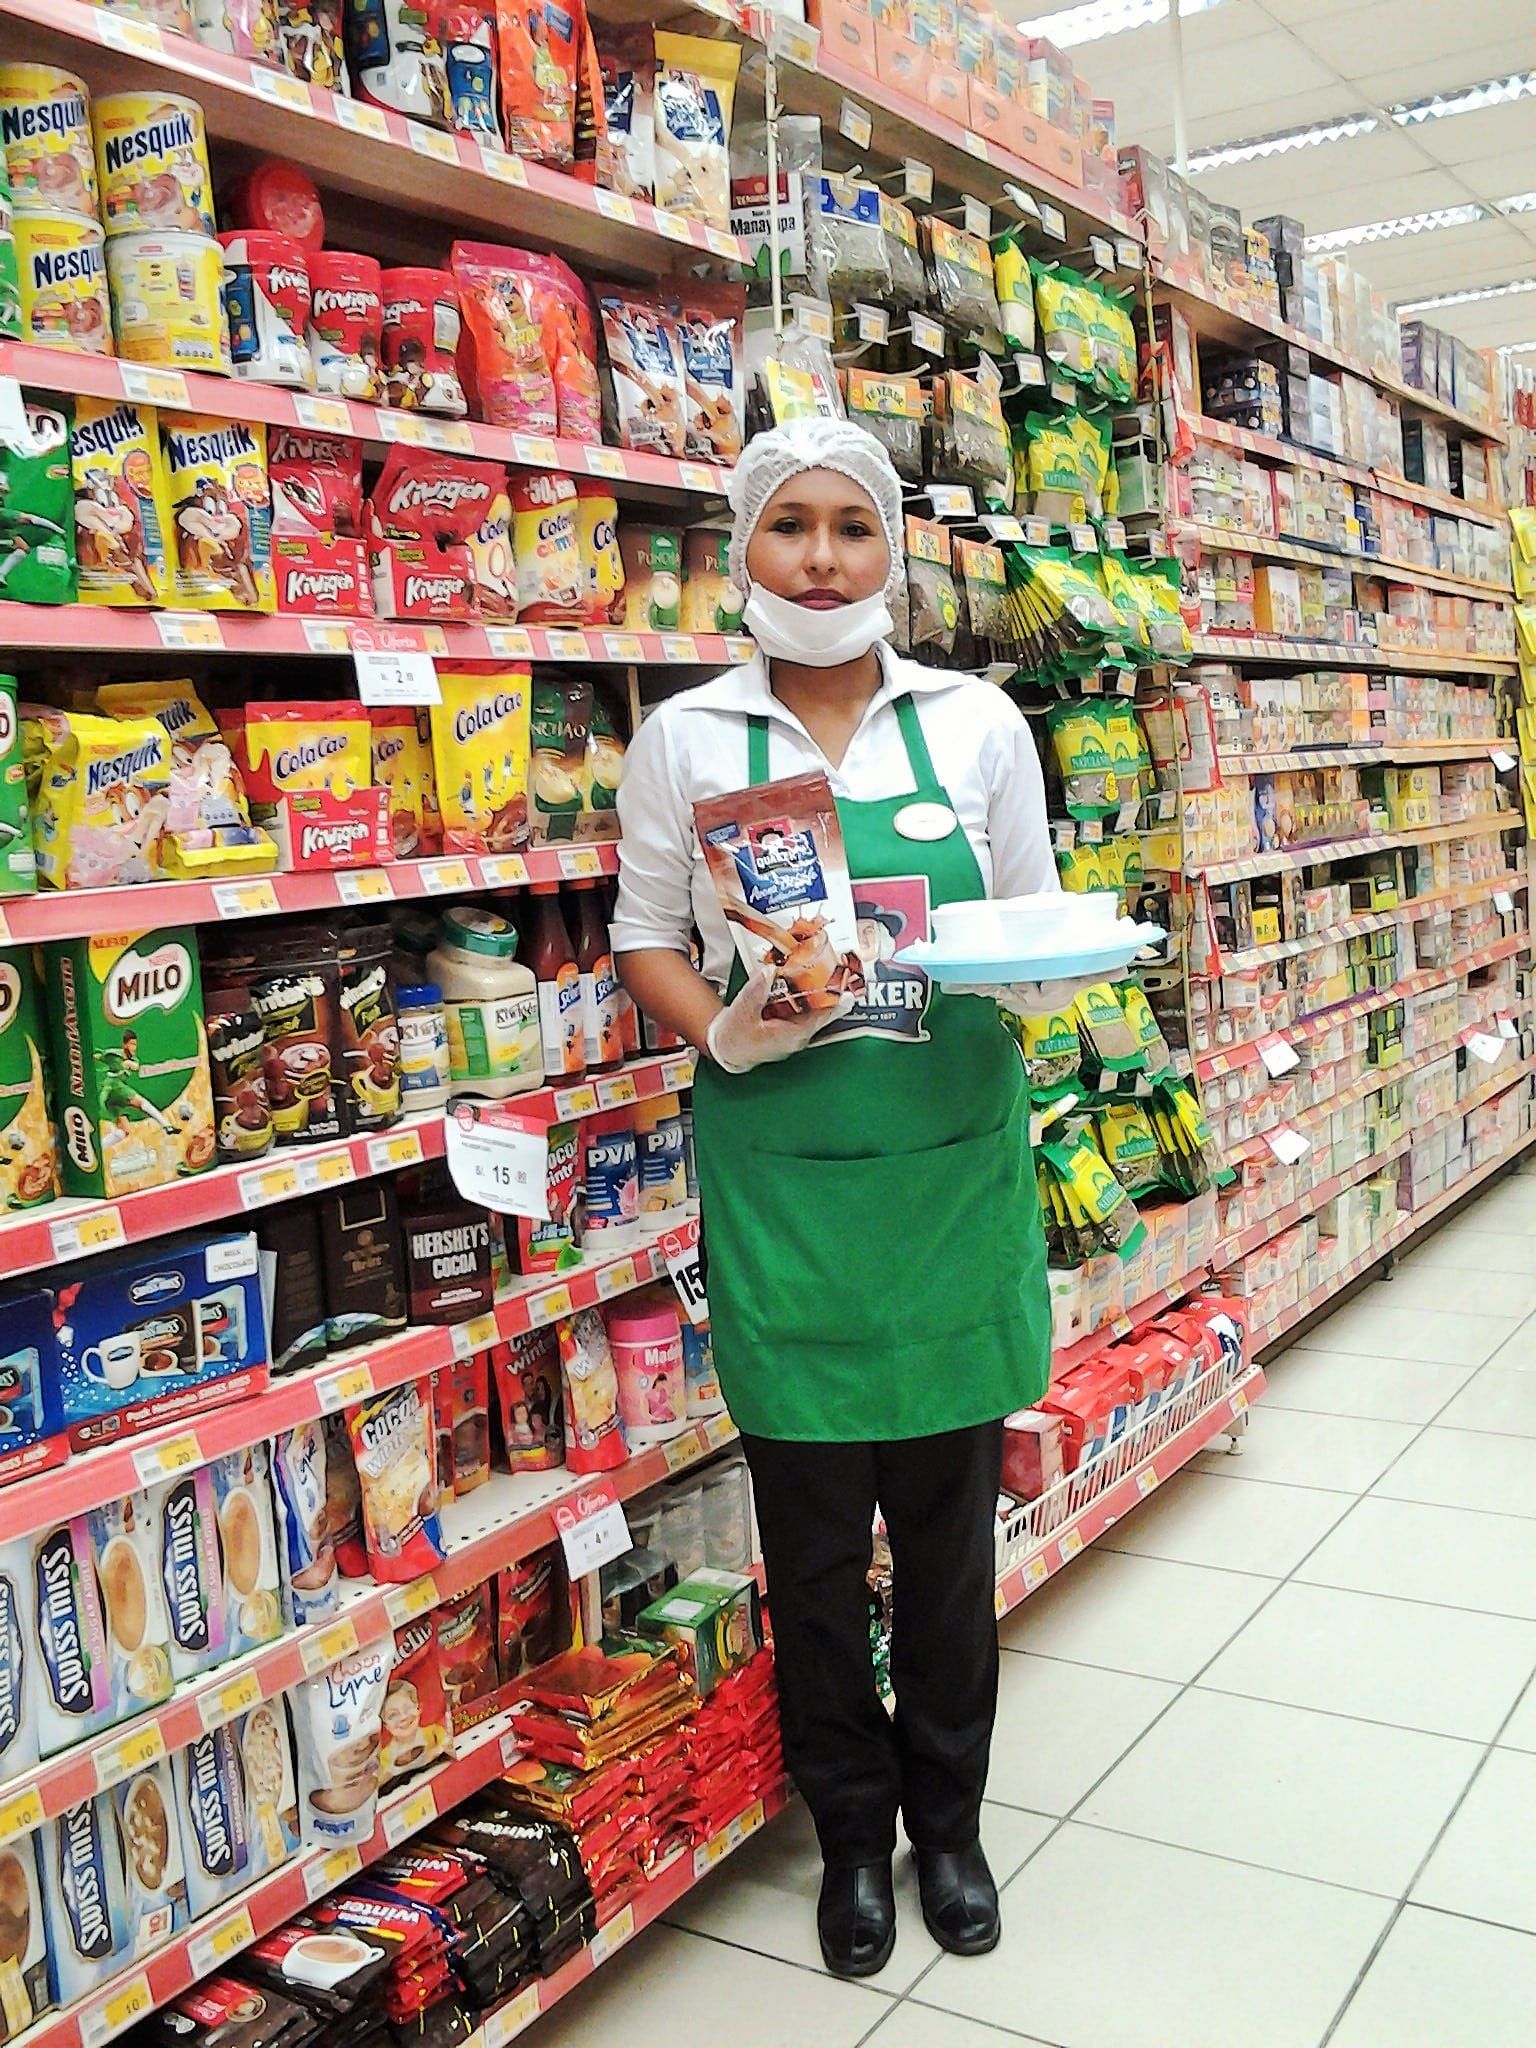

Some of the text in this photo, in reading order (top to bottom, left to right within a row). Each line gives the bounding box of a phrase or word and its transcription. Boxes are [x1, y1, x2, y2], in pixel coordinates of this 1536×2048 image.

[105, 112, 193, 174] Nesquik
[730, 216, 796, 237] Manaypa
[72, 403, 144, 458] esquik
[168, 422, 256, 475] Nesquik
[117, 963, 181, 1008] MILO
[73, 1112, 90, 1163] MILO
[492, 1164, 511, 1186] 15
[412, 1222, 490, 1260] HERSHEY'S
[432, 1251, 478, 1280] COCOA
[675, 1261, 706, 1306] 15
[194, 1738, 231, 1869] SWISS MIS
[75, 1865, 108, 1951] SWISS
